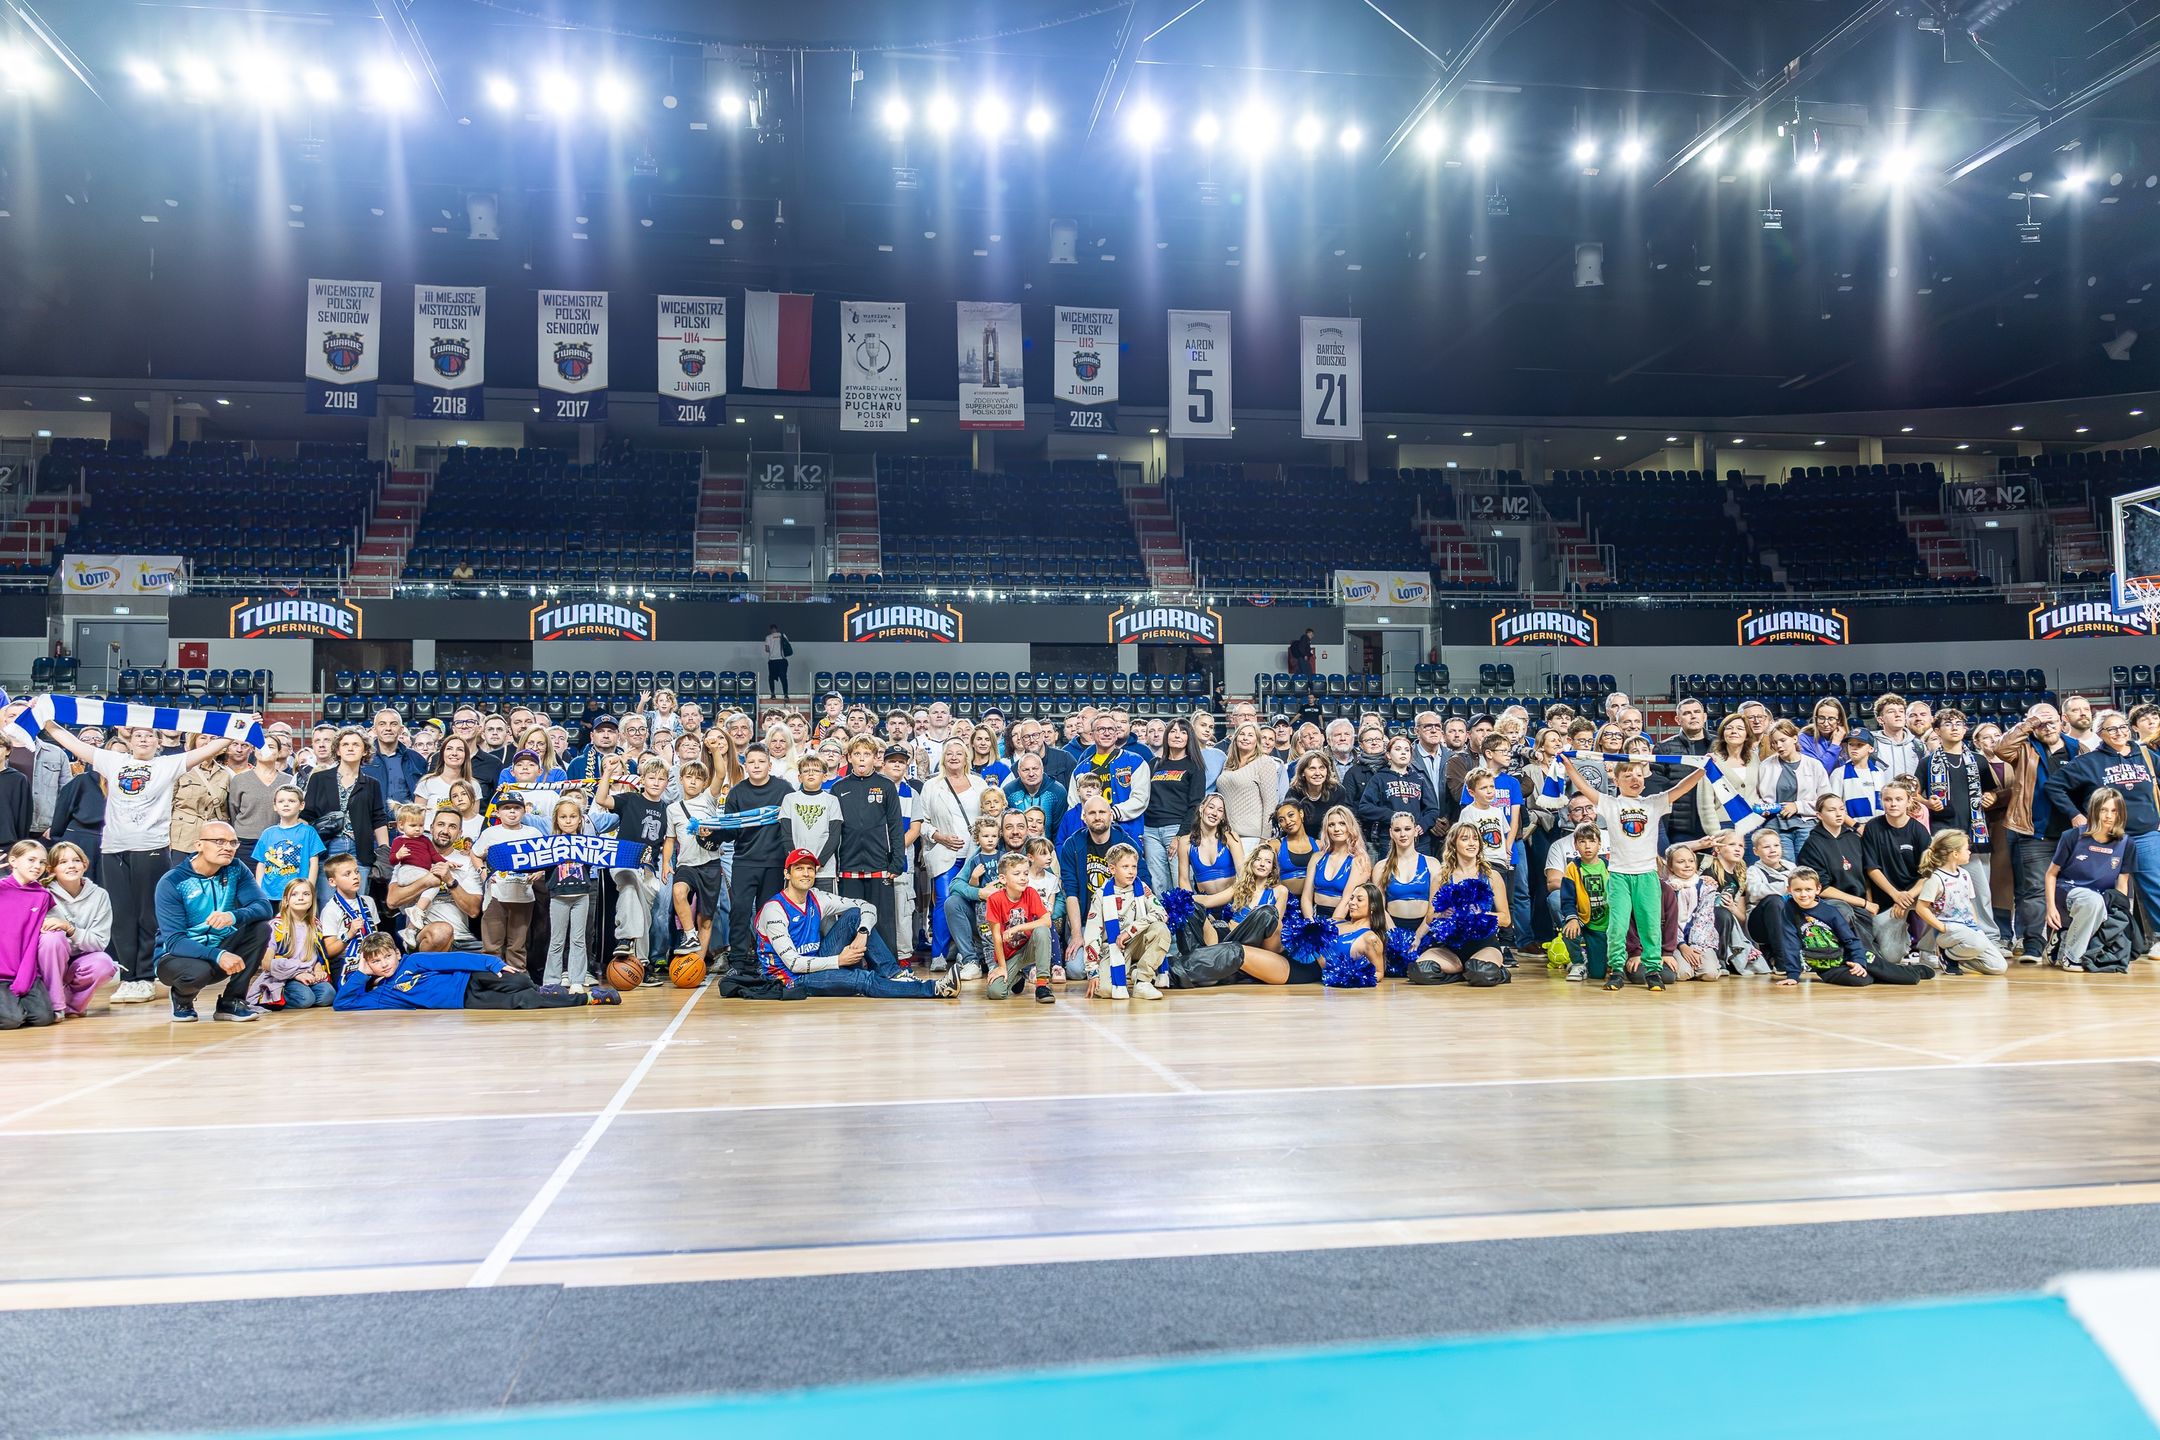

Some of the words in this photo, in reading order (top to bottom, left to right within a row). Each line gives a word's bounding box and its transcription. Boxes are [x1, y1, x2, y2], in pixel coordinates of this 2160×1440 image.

[315, 284, 375, 298] WICEMISTRZ
[424, 291, 433, 302] III
[436, 292, 476, 304] MIEJSCE
[327, 298, 361, 310] POLSKI
[543, 294, 603, 307] WICEMISTRZ
[419, 304, 481, 317] MISTRZOSTW
[555, 308, 591, 321] POLSKI
[660, 301, 724, 315] WICEMISTRZ
[318, 310, 370, 324] SENIORÓW
[674, 315, 710, 329] POLSKI
[1060, 311, 1113, 325] WICEMISTRZ
[433, 318, 467, 330] POLSKI
[546, 321, 600, 335] SENIORÓW
[1071, 324, 1102, 336] POLSKI
[684, 332, 700, 343] U14
[1078, 337, 1094, 348] U13
[1185, 338, 1214, 350] AARON
[324, 338, 362, 351] TWARDE
[431, 344, 469, 356] TWARDE
[555, 348, 591, 360] TWARDE
[1191, 350, 1208, 361] CEL
[674, 381, 711, 392] JUNIOR
[1068, 385, 1104, 396] JUNIOR
[324, 391, 358, 409] 2019
[845, 392, 902, 401] ZDOBYWCY
[1188, 369, 1214, 423] 5
[1315, 373, 1347, 426] 21
[433, 396, 467, 414] 2018
[557, 400, 589, 417] 2017
[845, 401, 902, 411] PUCHARU
[678, 405, 706, 422] 2014
[857, 411, 891, 419] POLSKI
[1070, 410, 1102, 428] 2023
[760, 464, 785, 483] J2
[793, 464, 822, 483] K2
[1955, 488, 1987, 506] M2
[1996, 485, 2026, 504] N2
[1502, 496, 1529, 513] M2
[79, 571, 110, 586] LOTTO
[1346, 585, 1372, 598] LOTTO
[1397, 586, 1423, 599] LOTTO
[238, 600, 354, 633] TWARDE
[537, 603, 648, 636] TWARDE
[850, 605, 955, 637] TWARDE
[268, 622, 324, 634] PIERNIKI
[1115, 608, 1215, 639] TWARDE
[1498, 611, 1591, 641] TWARDE
[1744, 611, 1841, 641] TWARDE
[2065, 623, 2119, 635] PIERNIKI
[567, 625, 620, 637] PIERNIKI
[879, 628, 928, 638] PIERNIKI
[1142, 629, 1189, 640] PIERNIKI
[1769, 633, 1815, 642] PIERNIKI
[1523, 633, 1567, 643] PIERNIKI
[645, 808, 662, 818] MESSI
[507, 835, 620, 853] TWARDE
[511, 846, 617, 870] PIERNIKI
